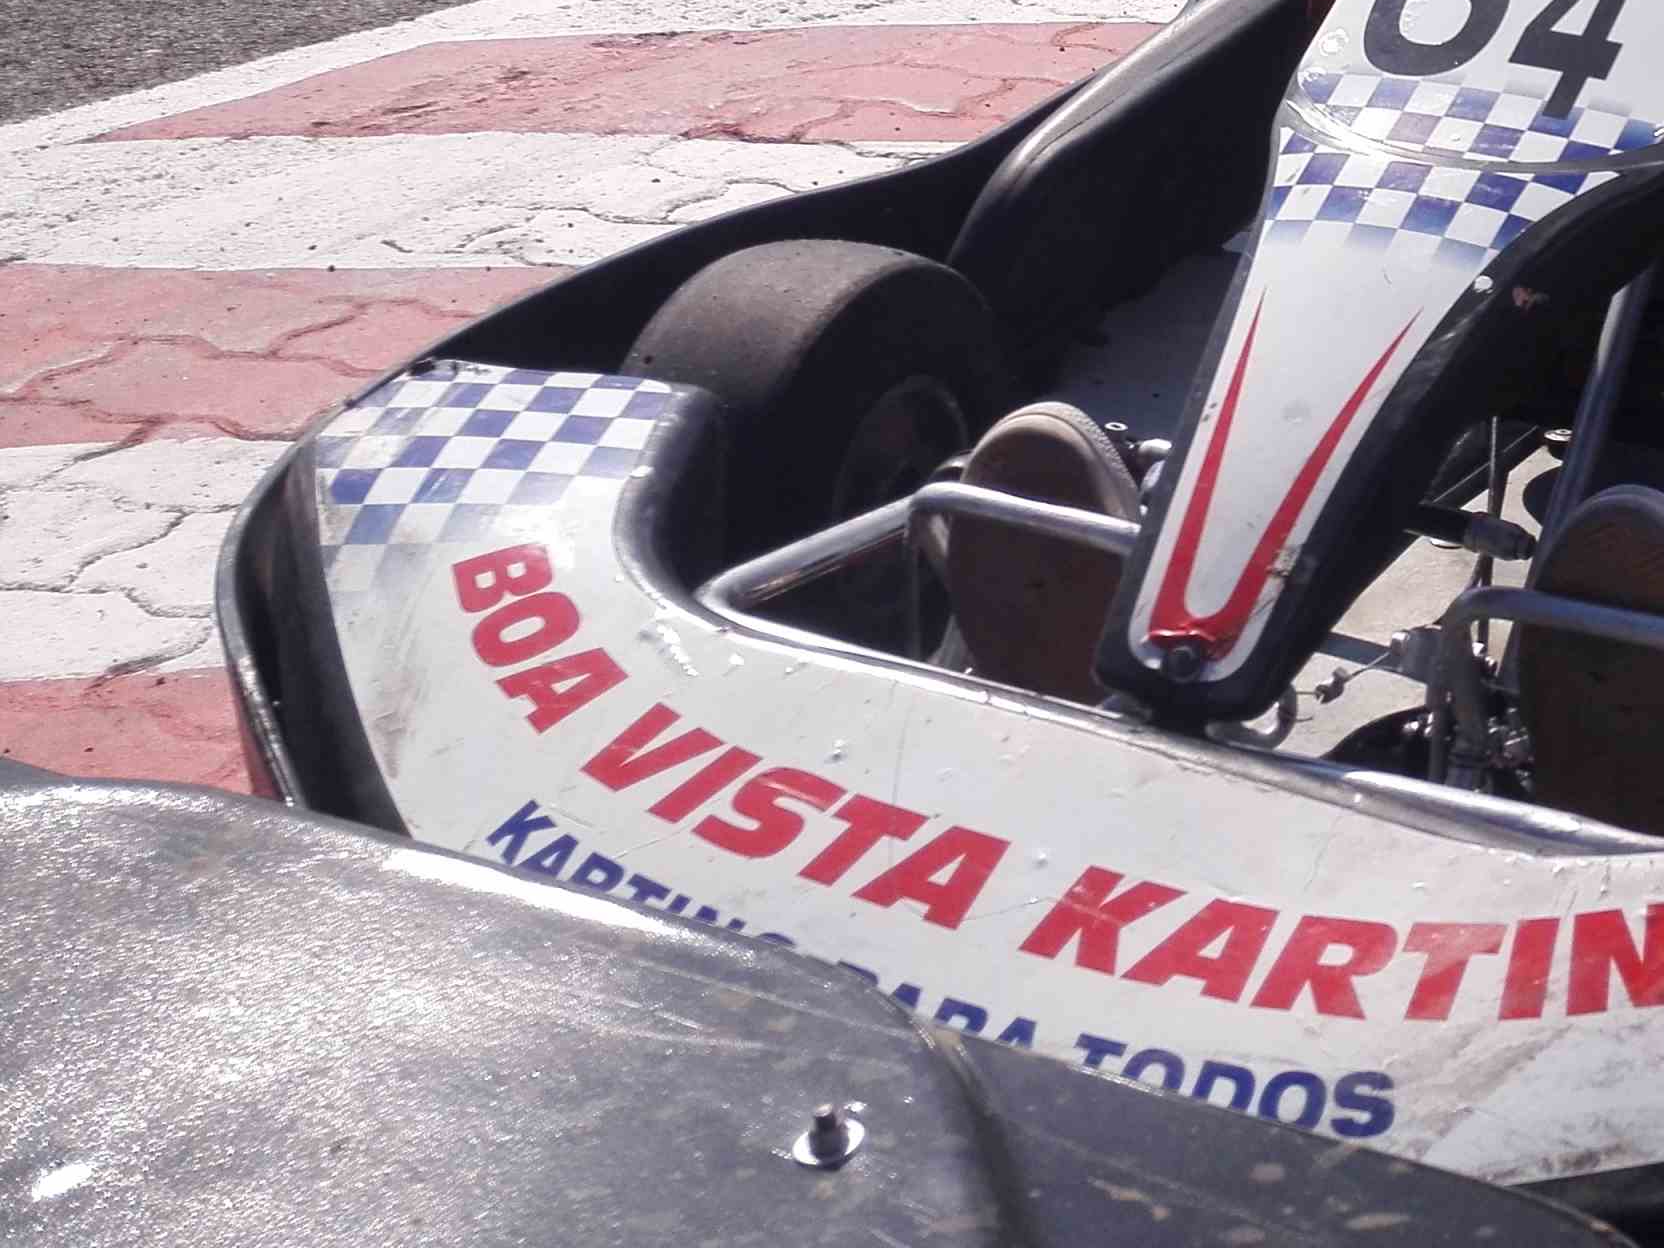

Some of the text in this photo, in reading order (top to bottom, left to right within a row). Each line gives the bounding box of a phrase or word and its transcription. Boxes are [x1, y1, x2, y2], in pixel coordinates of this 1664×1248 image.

[452, 543, 629, 735] BOA
[580, 701, 1011, 931] VISTA
[485, 799, 797, 946] KART
